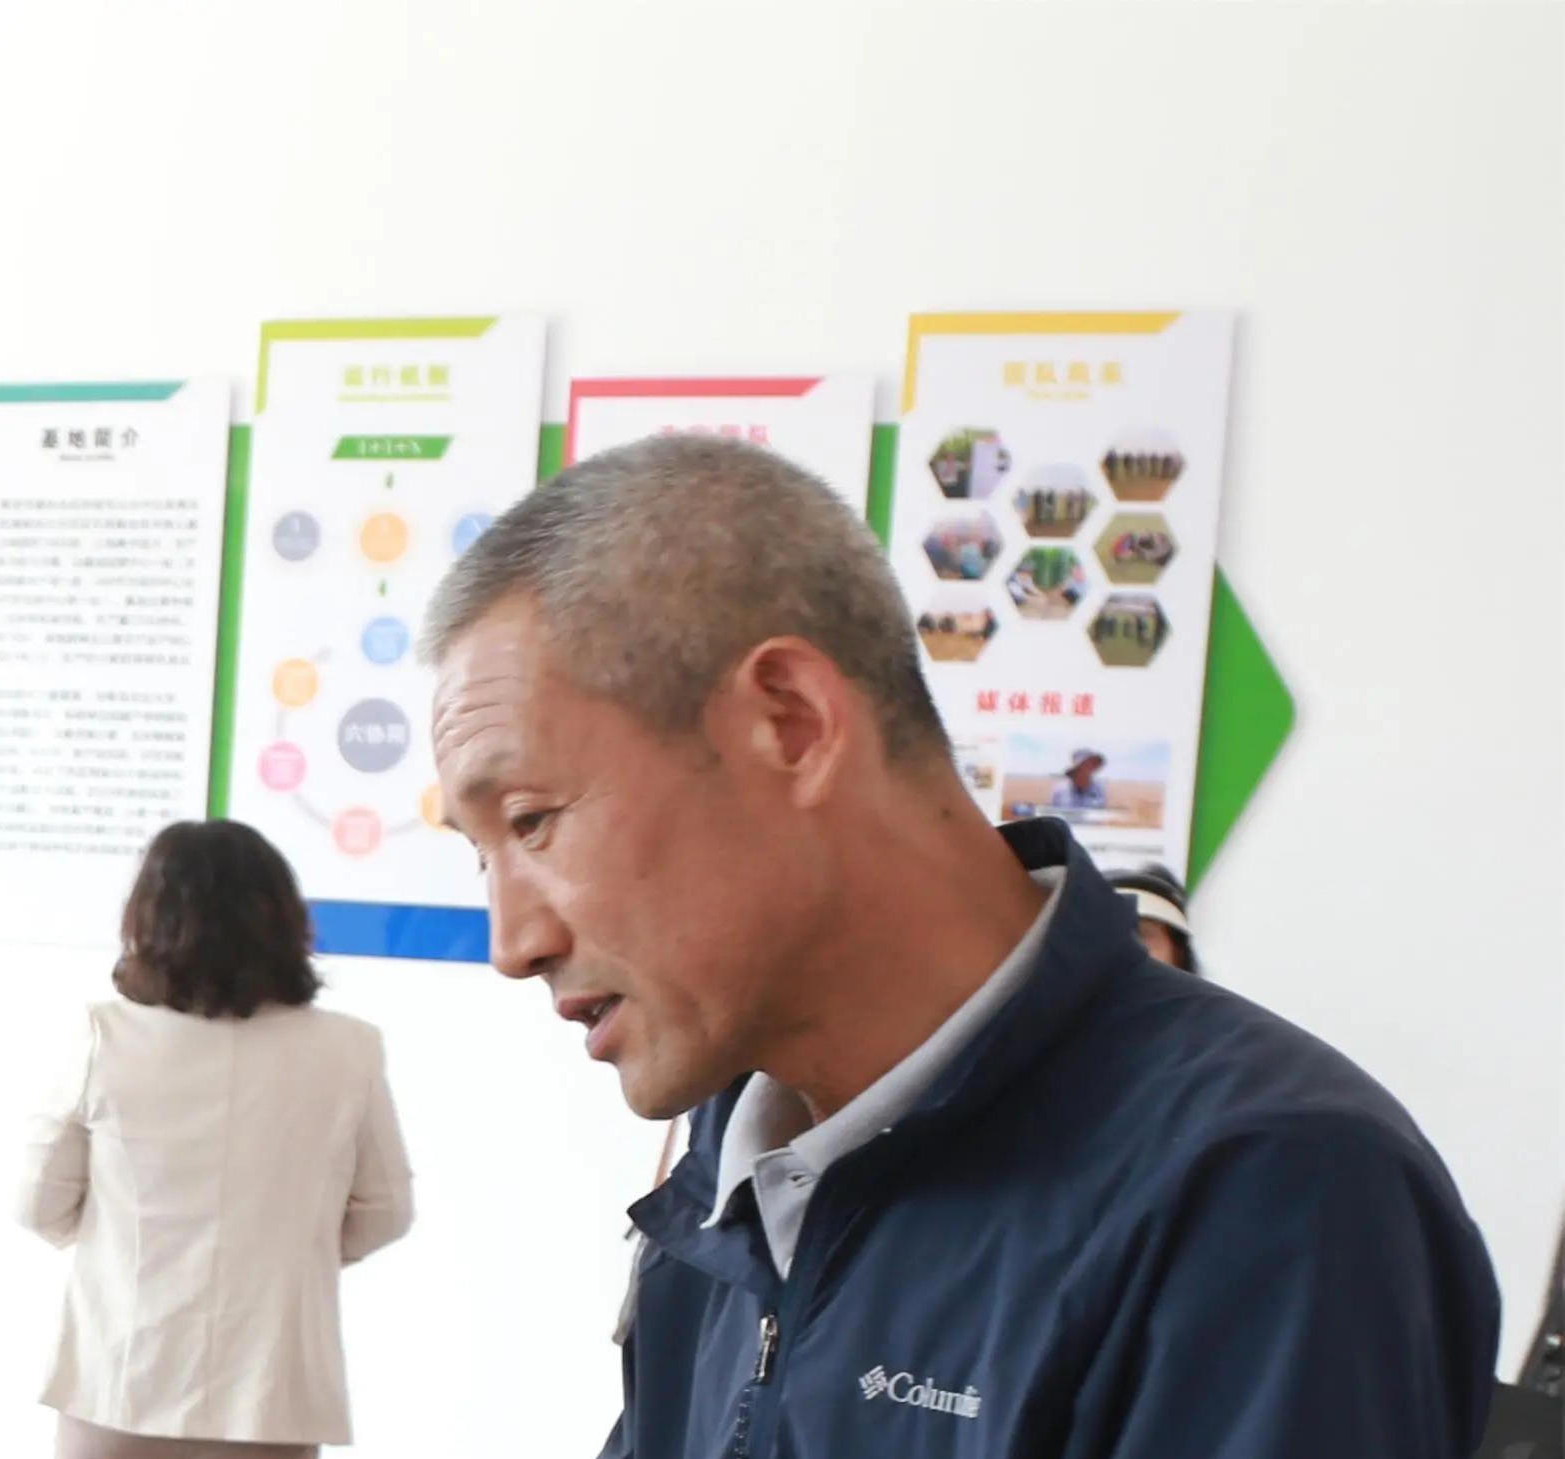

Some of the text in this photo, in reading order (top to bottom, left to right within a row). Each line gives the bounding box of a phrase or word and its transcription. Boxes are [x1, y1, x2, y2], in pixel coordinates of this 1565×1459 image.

[41, 426, 139, 448] 基地简介
[976, 689, 1094, 717] 媒体报道
